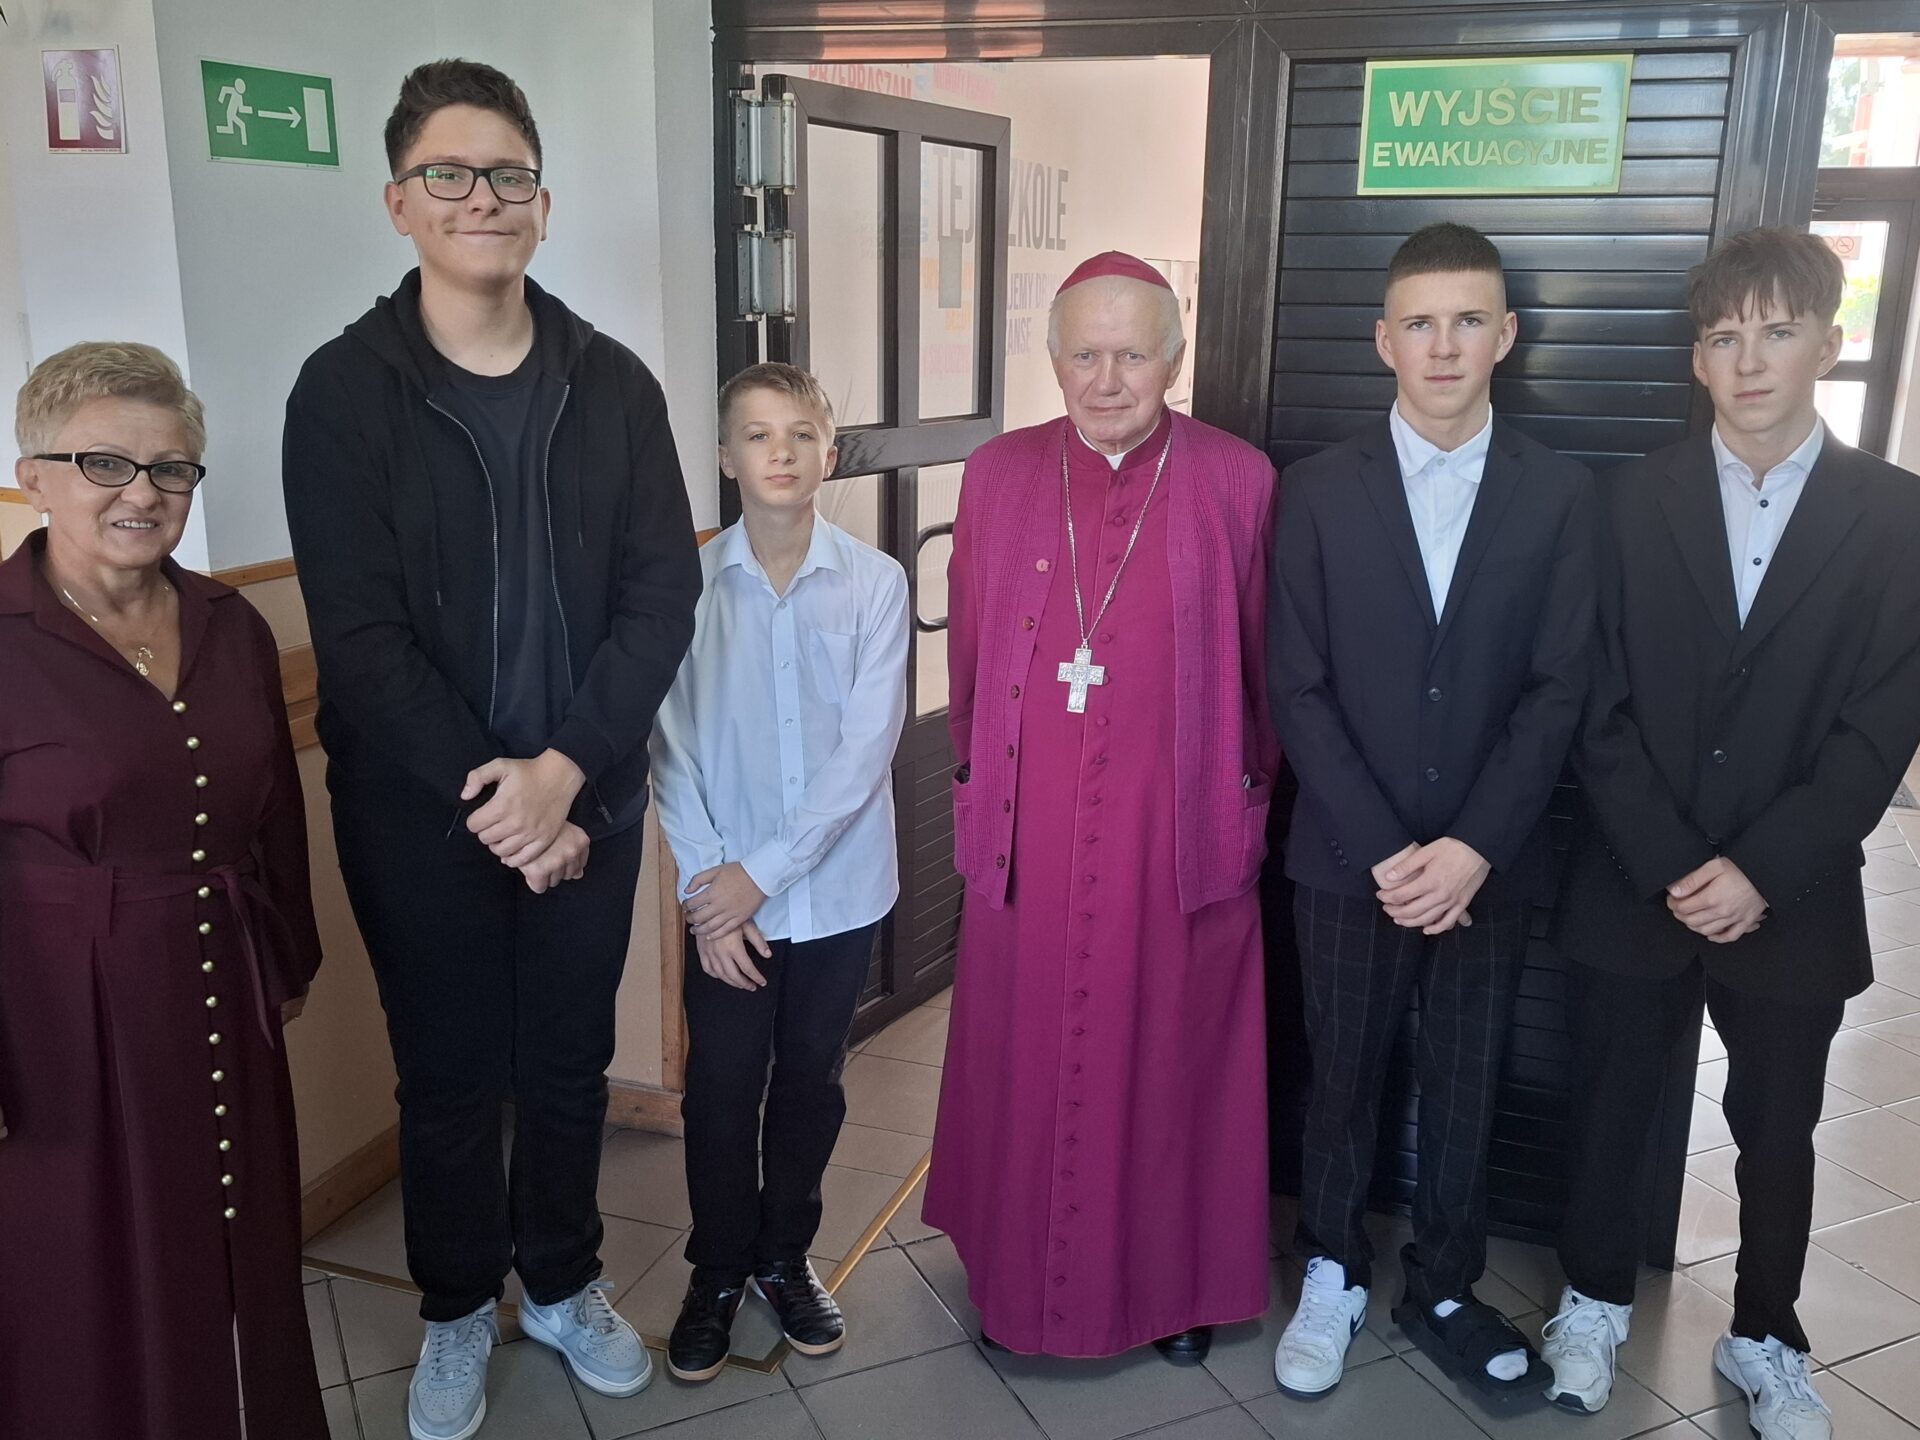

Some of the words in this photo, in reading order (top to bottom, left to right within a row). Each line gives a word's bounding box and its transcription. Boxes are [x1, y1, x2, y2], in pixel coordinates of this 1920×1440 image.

[1387, 79, 1602, 127] WYJŚCIE
[1372, 138, 1609, 167] EWAKUACYJNE
[933, 145, 975, 243] TEJ
[1008, 158, 1069, 251] ZKOLE
[1007, 272, 1033, 310] JEMY
